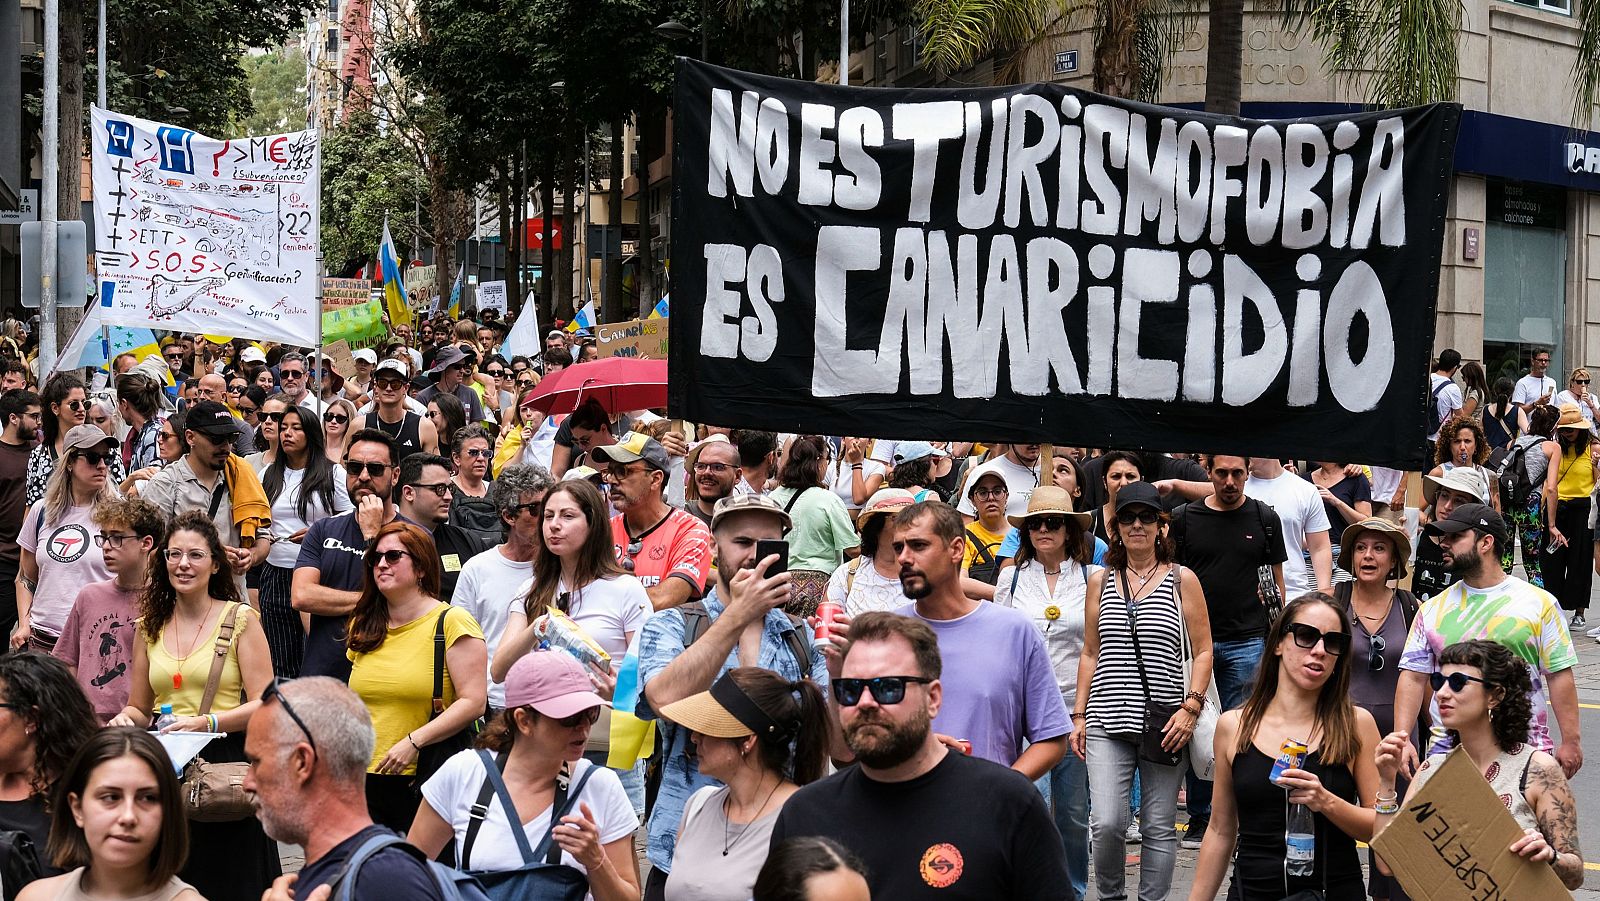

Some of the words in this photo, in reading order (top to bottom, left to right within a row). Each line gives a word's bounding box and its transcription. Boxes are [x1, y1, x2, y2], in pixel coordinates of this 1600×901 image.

[1168, 30, 1300, 52] EDCIO
[1164, 64, 1308, 86] VITICIO
[110, 123, 130, 149] H
[162, 129, 192, 172] H
[707, 87, 789, 198] NO
[797, 102, 884, 210] ES
[139, 229, 174, 245] ETT
[246, 304, 280, 321] Spring
[700, 243, 785, 362] ES
[88, 612, 118, 640] CENTRAL
